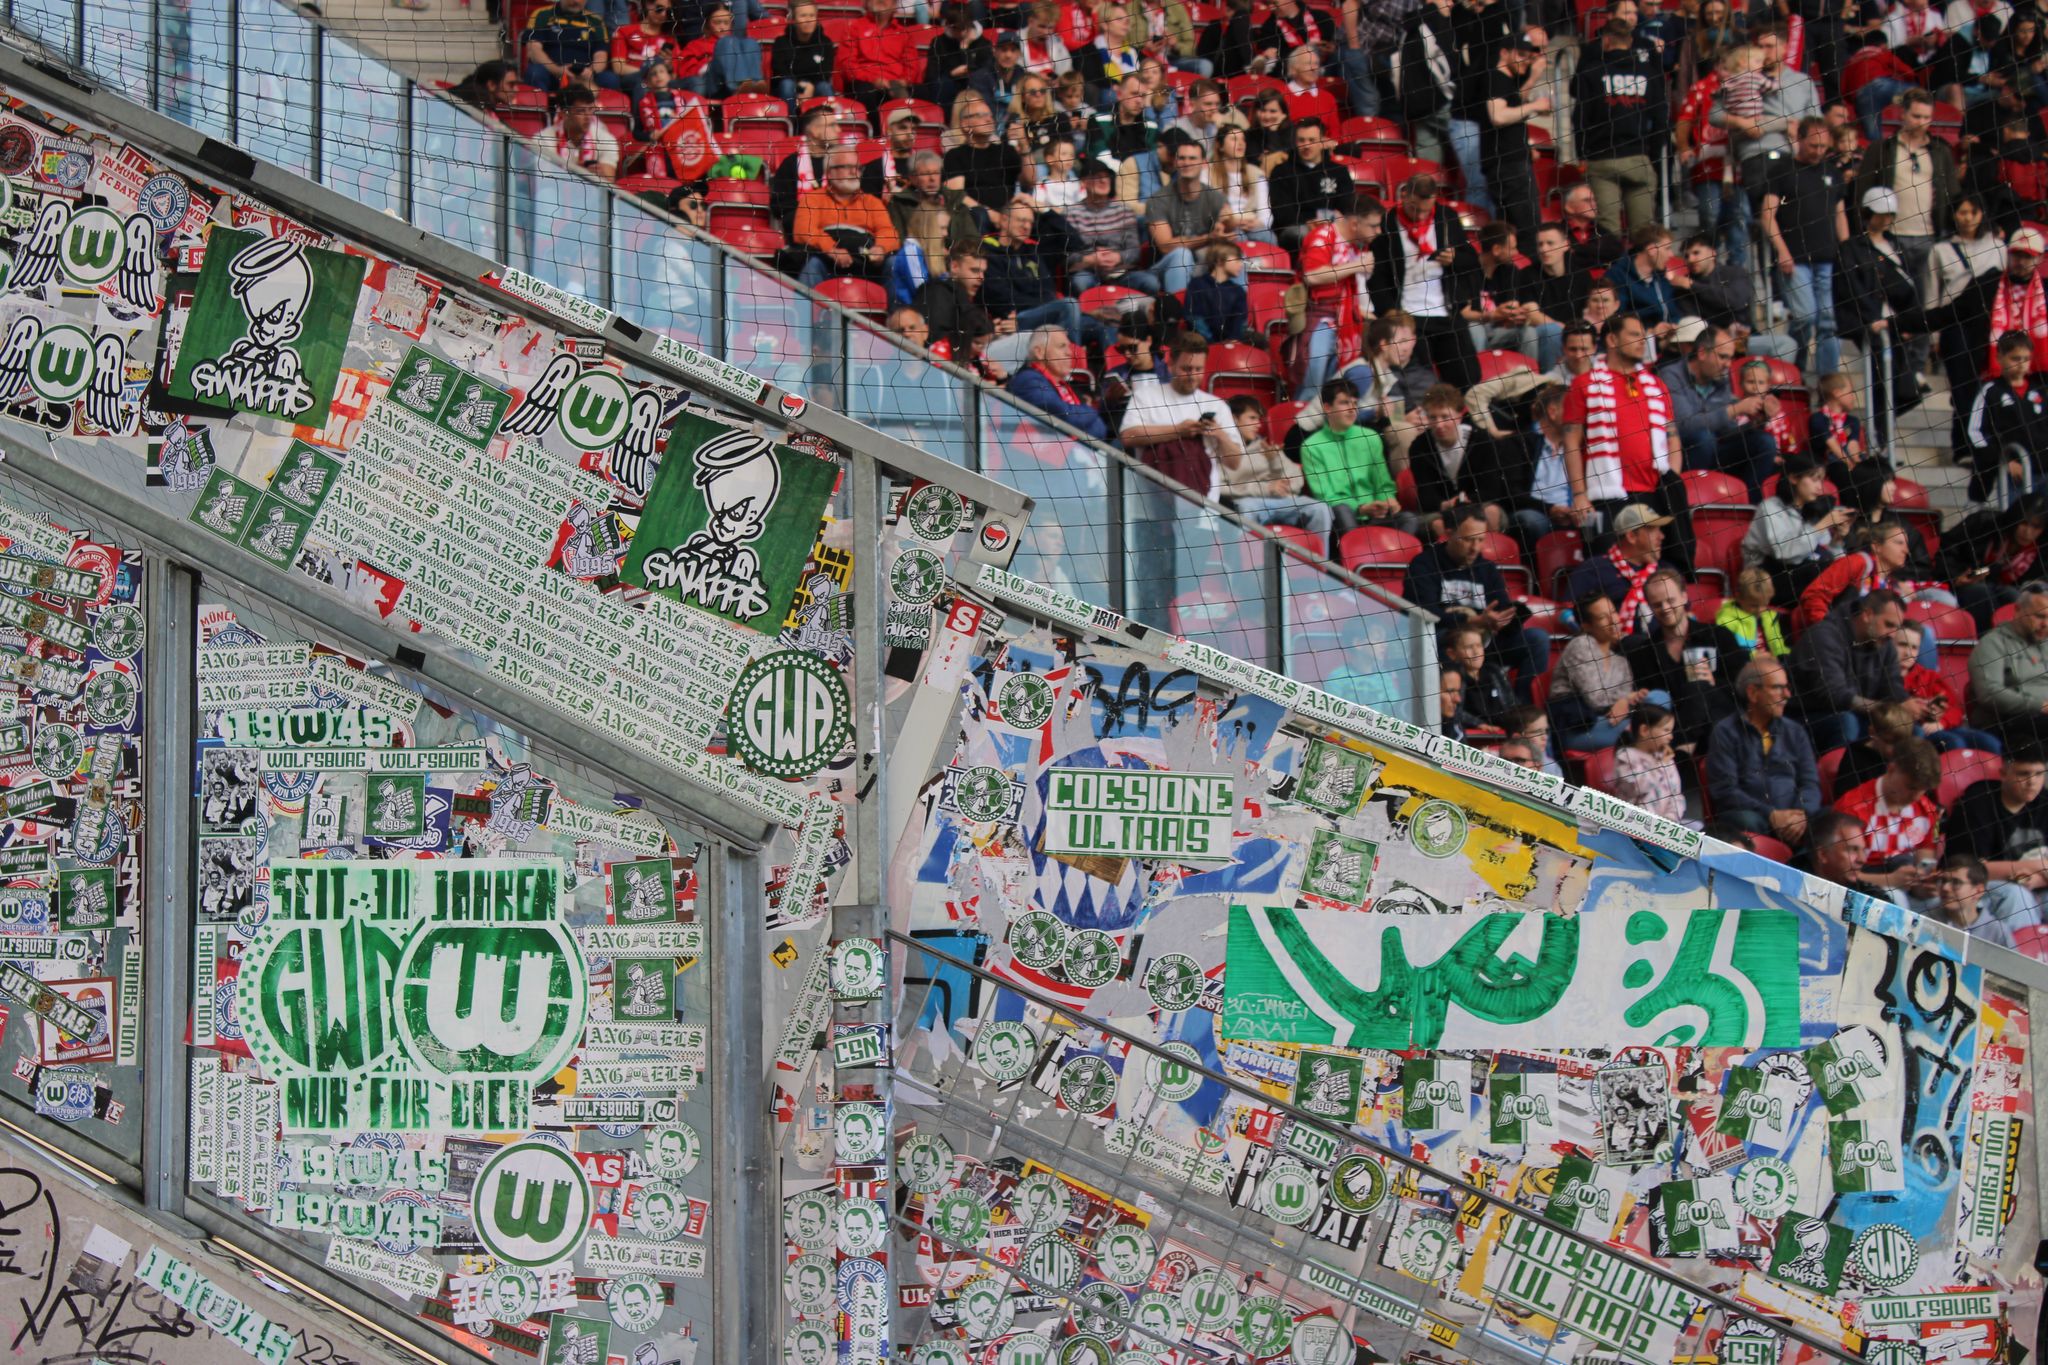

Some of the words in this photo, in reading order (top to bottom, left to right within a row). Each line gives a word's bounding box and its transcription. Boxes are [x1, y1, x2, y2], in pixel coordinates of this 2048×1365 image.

[508, 269, 546, 298] ANG
[568, 297, 609, 322] ELS
[655, 337, 699, 366] ANG
[721, 366, 761, 392] ELS
[370, 403, 408, 435] ANG
[428, 433, 468, 464] ELS
[469, 455, 507, 487] ANG
[528, 485, 568, 516] ELS
[512, 443, 550, 475] ANG
[571, 473, 611, 504] ELS
[330, 485, 368, 517] ANG
[388, 516, 428, 547] ELS
[316, 512, 354, 544] ANG
[374, 542, 414, 573] ELS
[571, 554, 615, 577] 1995
[428, 536, 466, 568] ANG
[487, 567, 527, 598] ELS
[536, 571, 574, 603] ANG
[596, 600, 636, 631] ELS
[982, 566, 1025, 593] ANG
[1049, 593, 1093, 617] ELS
[400, 591, 438, 623] ANG
[459, 621, 499, 652] ELS
[649, 599, 687, 631] ANG
[711, 628, 751, 659] ELS
[799, 628, 845, 649] 1995
[201, 651, 240, 670] ANG
[266, 649, 306, 667] ELS
[624, 650, 662, 682] ANG
[685, 680, 725, 711] ELS
[1186, 642, 1230, 672] ANG
[1254, 670, 1298, 697] ELS
[201, 684, 241, 702] ANG
[268, 681, 308, 699] ELS
[314, 665, 354, 692] ANG
[377, 687, 417, 714] ELS
[495, 654, 533, 686] ANG
[555, 684, 595, 715] ELS
[598, 707, 636, 739] ANG
[659, 737, 699, 768] ELS
[744, 666, 835, 762] GWA
[1304, 689, 1348, 717] ANG
[1376, 713, 1420, 739] ELS
[266, 752, 366, 769] WOLFSBURG
[380, 752, 480, 769] WOLFSBURG
[1439, 740, 1485, 767] ANG
[1514, 761, 1559, 787] ELS
[8, 785, 50, 807] Brothers
[700, 759, 738, 791] ANG
[763, 788, 803, 819] ELS
[1047, 772, 1233, 814] COESIONE
[1314, 790, 1342, 808] 1995
[383, 820, 408, 830] 1995
[551, 805, 593, 834] ANG
[618, 822, 662, 848] ELS
[805, 796, 833, 846] ANG
[1067, 814, 1210, 854] ULTRAS
[1580, 794, 1626, 822] ANG
[1653, 820, 1703, 848] ELS
[1, 851, 46, 866] Brothers
[273, 868, 349, 920] SEIT
[432, 868, 558, 921] JAHREN
[786, 872, 812, 917] ELS
[1321, 878, 1349, 895] 1995
[633, 906, 657, 918] 1995
[588, 931, 631, 949] ANG
[657, 931, 701, 948] ELS
[120, 951, 140, 1058] WOLFSBURG
[197, 931, 214, 1037] WOLFSBURG
[632, 1004, 656, 1015] 1995
[590, 1027, 632, 1045] ANG
[660, 1029, 703, 1048] ELS
[835, 1036, 880, 1065] CSN
[198, 1062, 214, 1105] ANG
[225, 1076, 242, 1120] ANG
[581, 1066, 623, 1085] ANG
[650, 1064, 694, 1083] ELS
[254, 1088, 271, 1133] ANG
[287, 1077, 349, 1130] NUR
[451, 1078, 529, 1130] DICH
[563, 1100, 640, 1117] WOLFSBURG
[1312, 1100, 1339, 1112] 1995
[197, 1134, 213, 1179] ELS
[1109, 1127, 1155, 1158] ANG
[1180, 1155, 1226, 1187] ELS
[1289, 1125, 1336, 1163] CSN
[224, 1150, 241, 1194] ELS
[252, 1162, 269, 1206] ELS
[1975, 1119, 2006, 1239] WOLFSBURG
[330, 1245, 373, 1269] ANG
[396, 1265, 438, 1289] ELS
[588, 1243, 632, 1263] ANG
[659, 1249, 703, 1269] ELS
[1032, 1240, 1074, 1290] GWA
[1504, 1214, 1692, 1326] COESIONE
[1866, 1228, 1912, 1279] GWA
[858, 1284, 879, 1339] ANG
[1508, 1260, 1658, 1354] ULTRAS
[1871, 1296, 1991, 1320] WOLFSBURG
